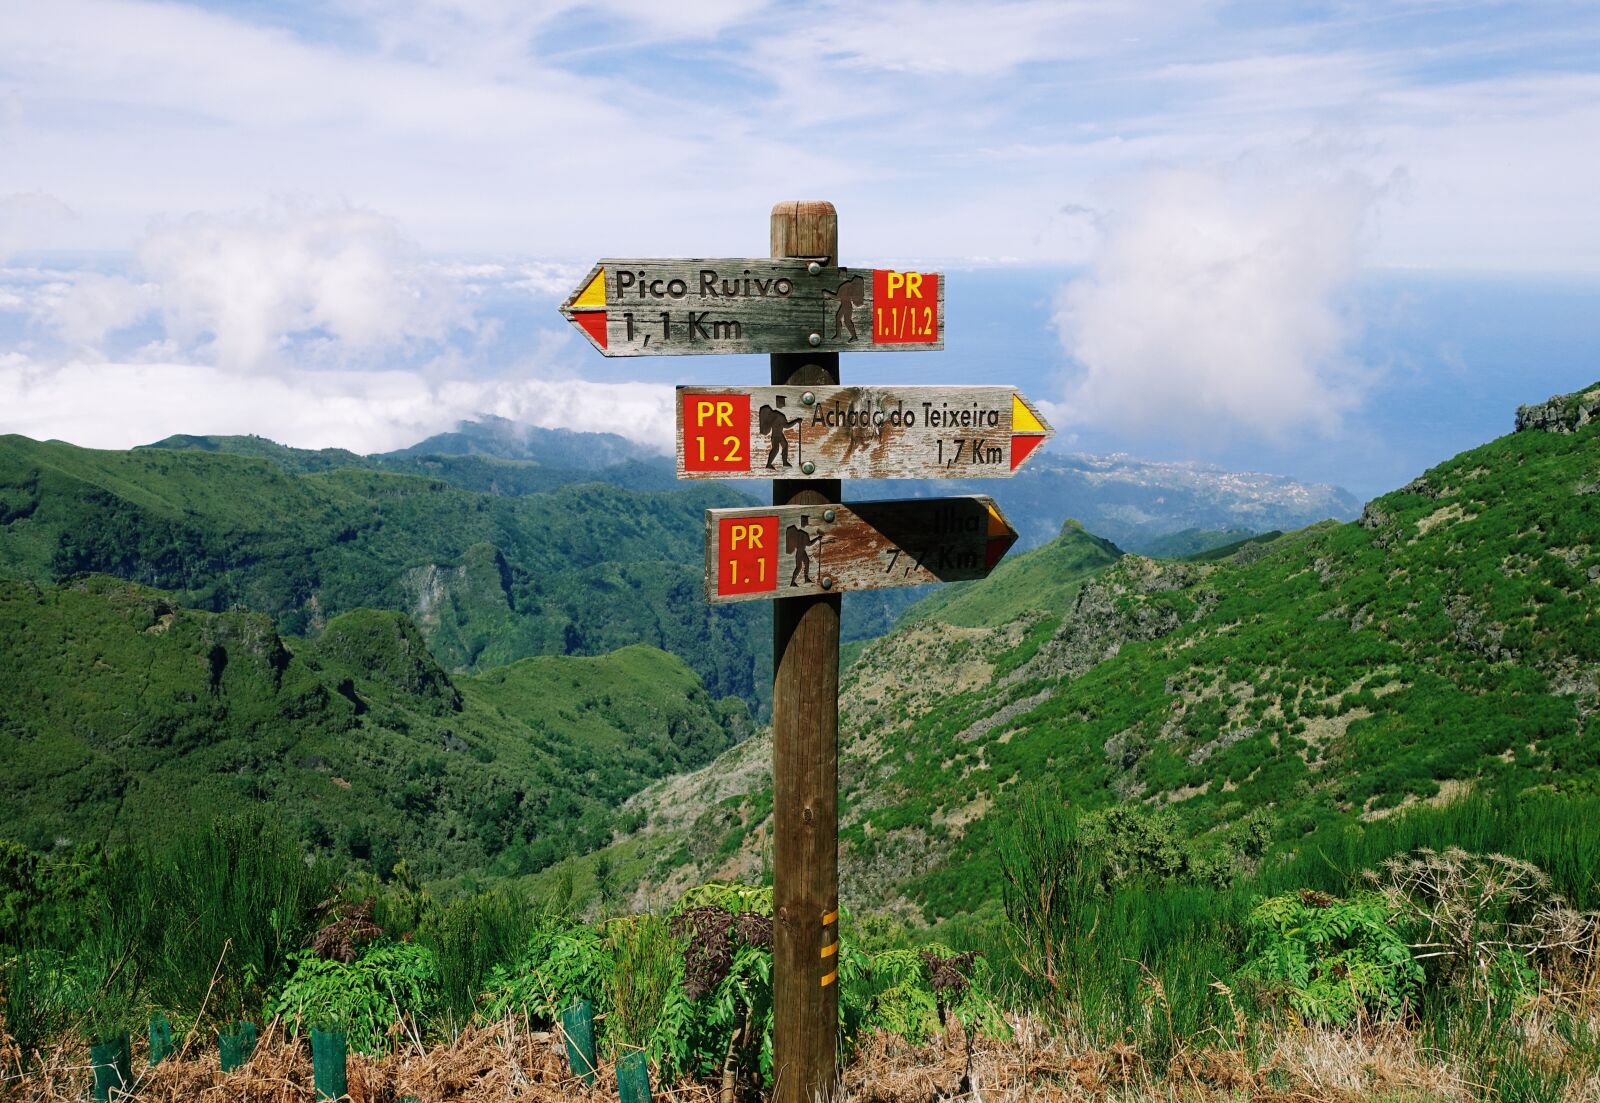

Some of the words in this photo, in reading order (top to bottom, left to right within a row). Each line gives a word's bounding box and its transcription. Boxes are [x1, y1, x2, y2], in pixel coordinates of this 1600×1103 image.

[616, 271, 687, 300] Pico
[700, 270, 794, 298] Ruivo
[887, 272, 924, 299] PR
[623, 312, 671, 347] 1,1
[689, 311, 742, 340] Km
[876, 306, 933, 339] 1.1/1.2
[697, 401, 734, 427] PR
[811, 403, 885, 428] Achada
[891, 403, 915, 428] do
[922, 402, 999, 428] Teixeira
[696, 436, 743, 462] 1.2
[936, 439, 964, 468] 1,7
[972, 439, 1003, 464] Km
[933, 507, 980, 535] Ilha
[730, 524, 764, 550] PR
[729, 557, 766, 585] 1.1
[886, 549, 929, 578] 7,7
[938, 545, 979, 570] Km
